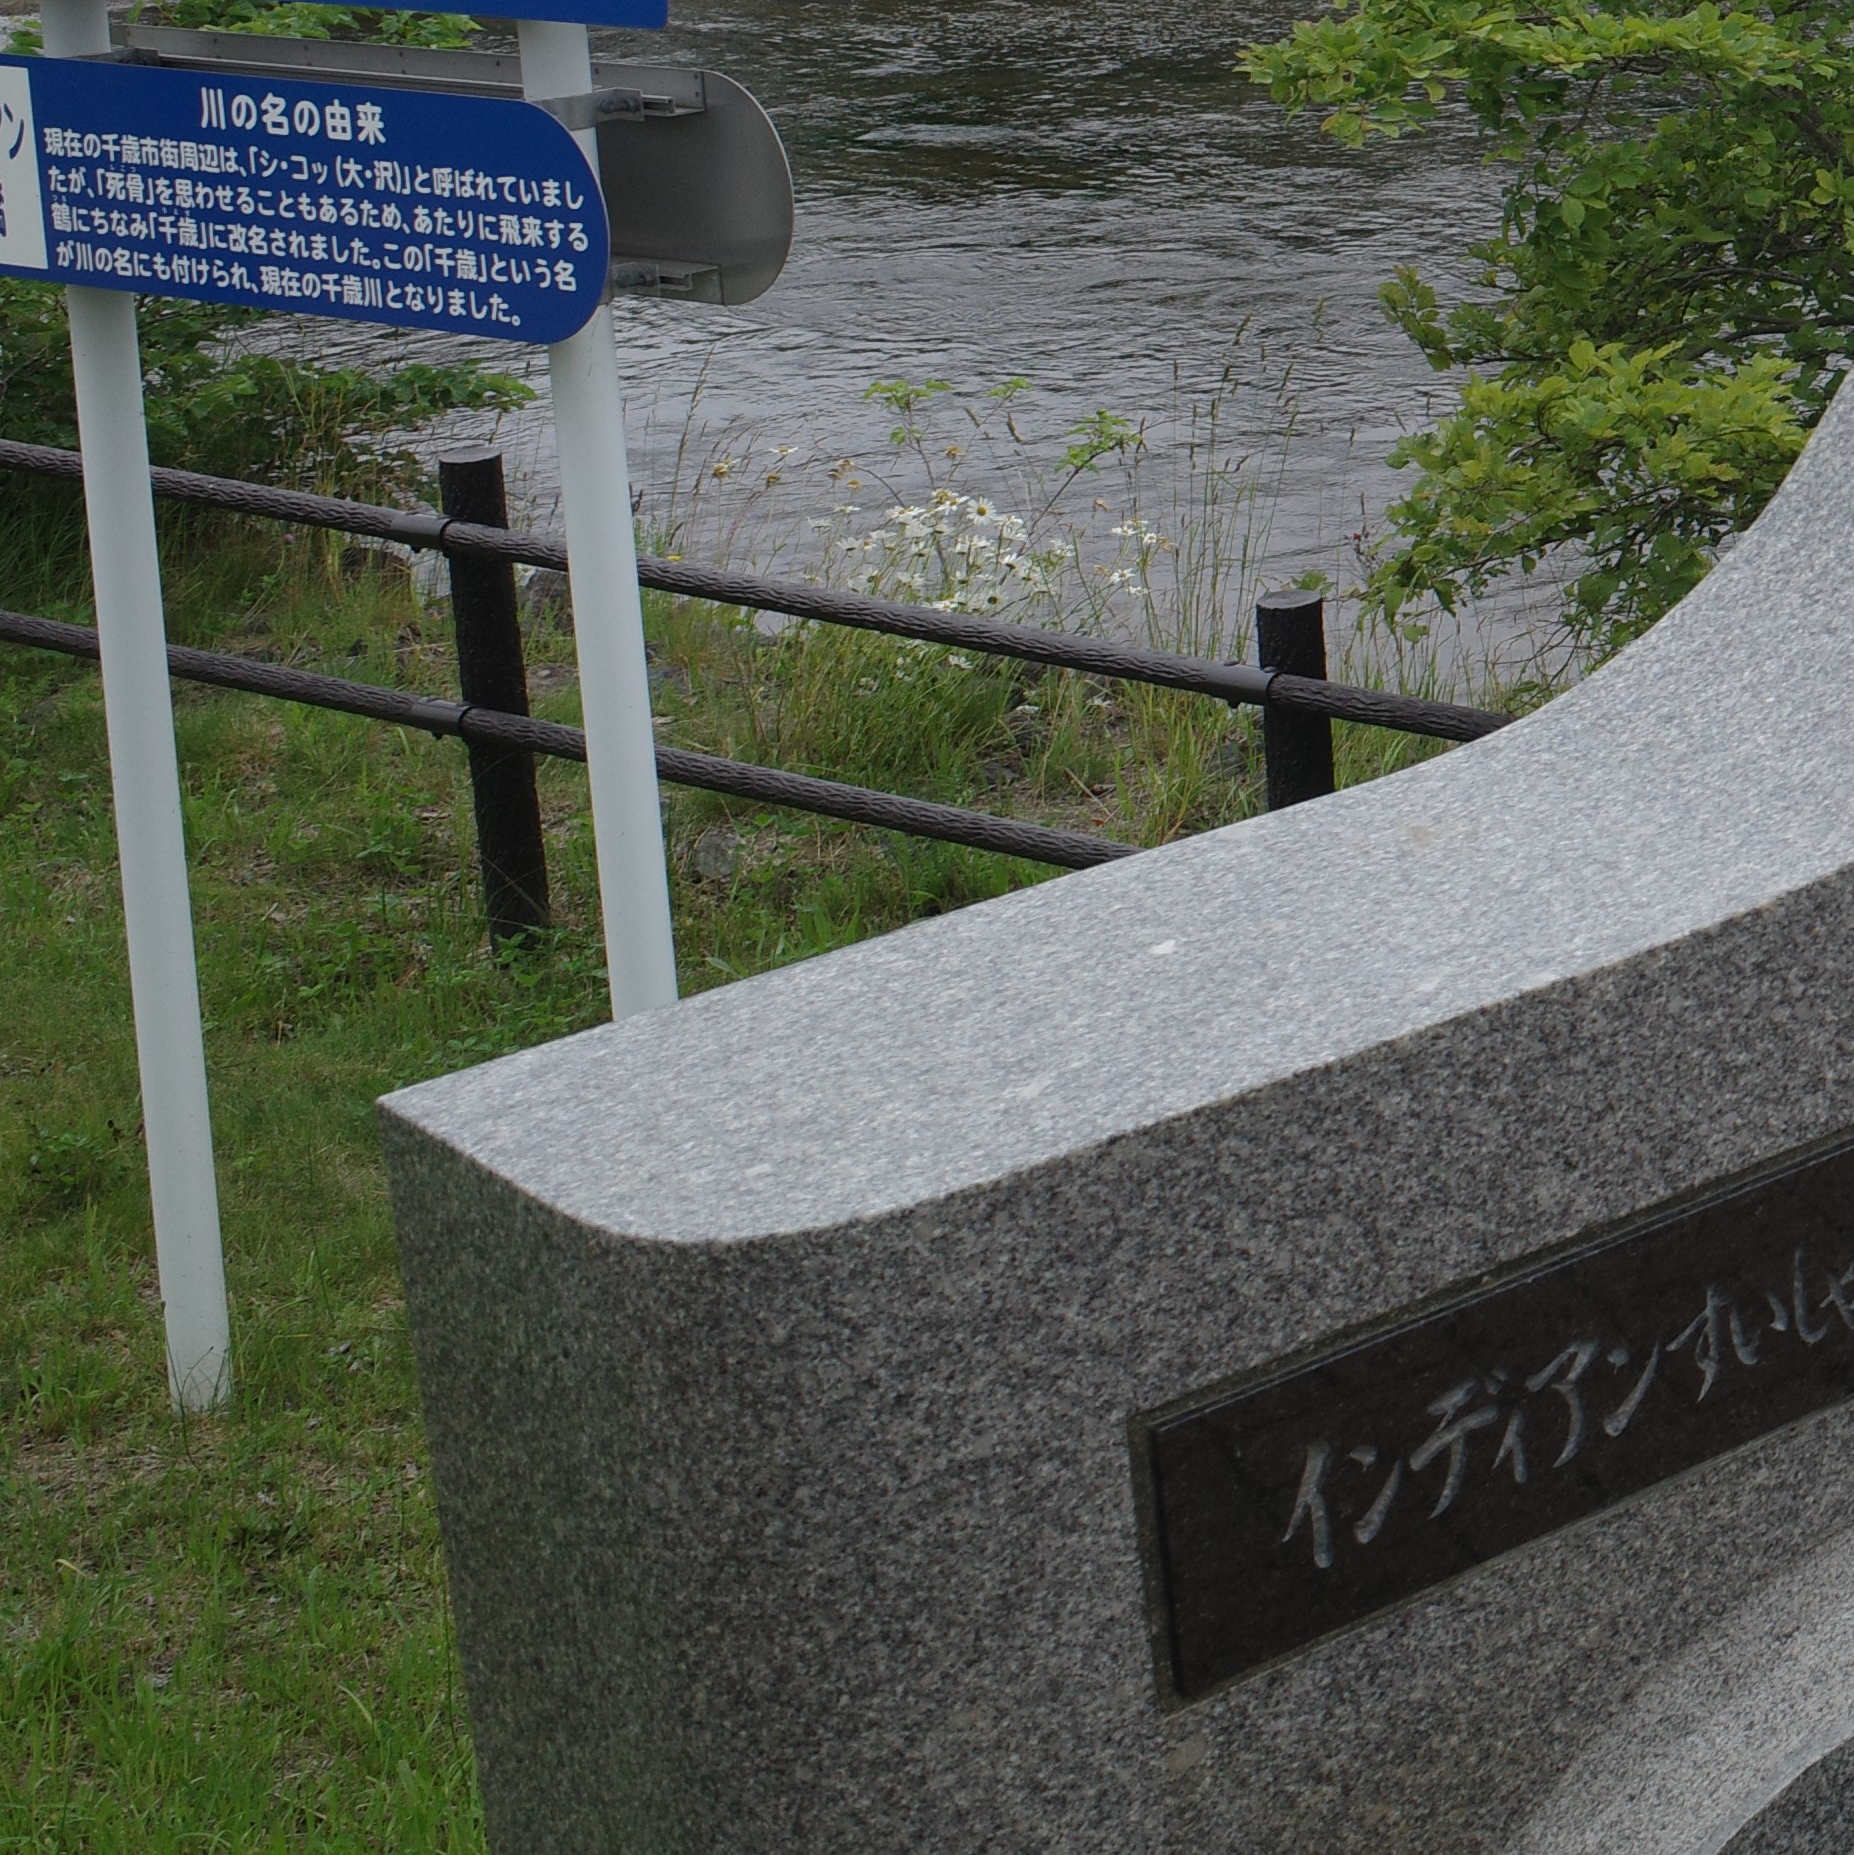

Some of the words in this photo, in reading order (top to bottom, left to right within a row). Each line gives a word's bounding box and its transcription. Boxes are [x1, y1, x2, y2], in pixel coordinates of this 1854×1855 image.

[200, 86, 387, 146] 川の名の由来
